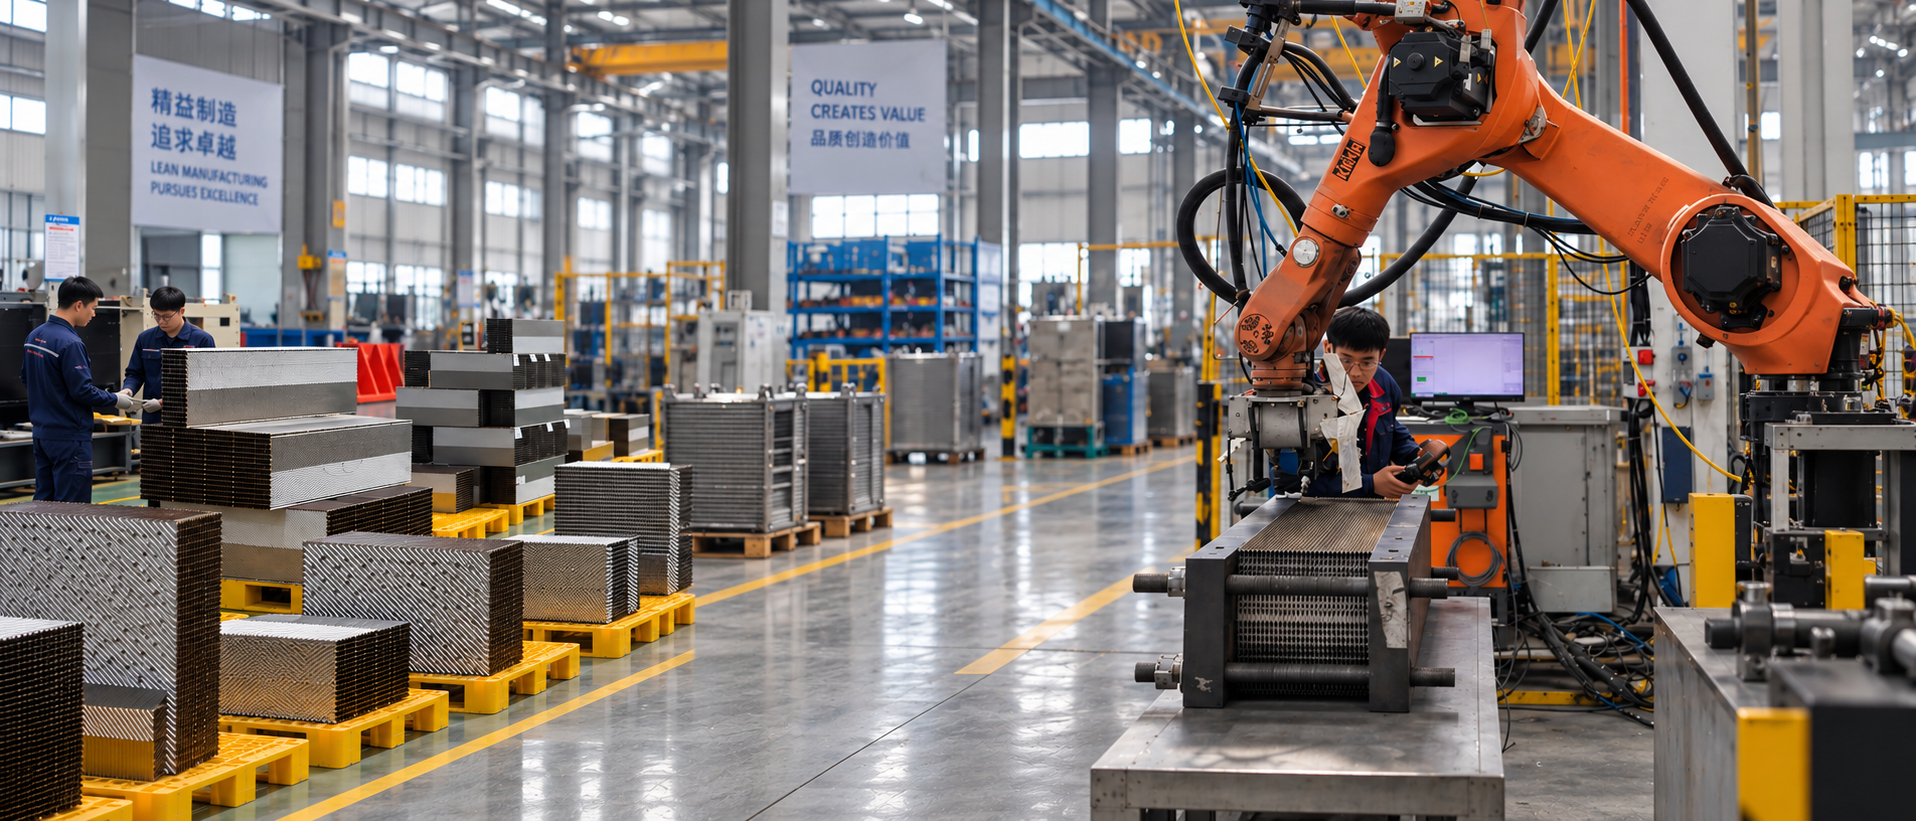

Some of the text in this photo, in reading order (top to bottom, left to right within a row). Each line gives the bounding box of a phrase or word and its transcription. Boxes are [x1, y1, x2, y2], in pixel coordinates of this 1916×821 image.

[811, 79, 877, 97] QUALITY
[151, 87, 237, 128] 精益制造
[811, 104, 926, 122] CREATES VALUE
[151, 122, 237, 160] 追求卓越
[151, 160, 268, 189] LEAN MANUFACTURING
[151, 181, 258, 206] PURSUES EXCELLENCE
